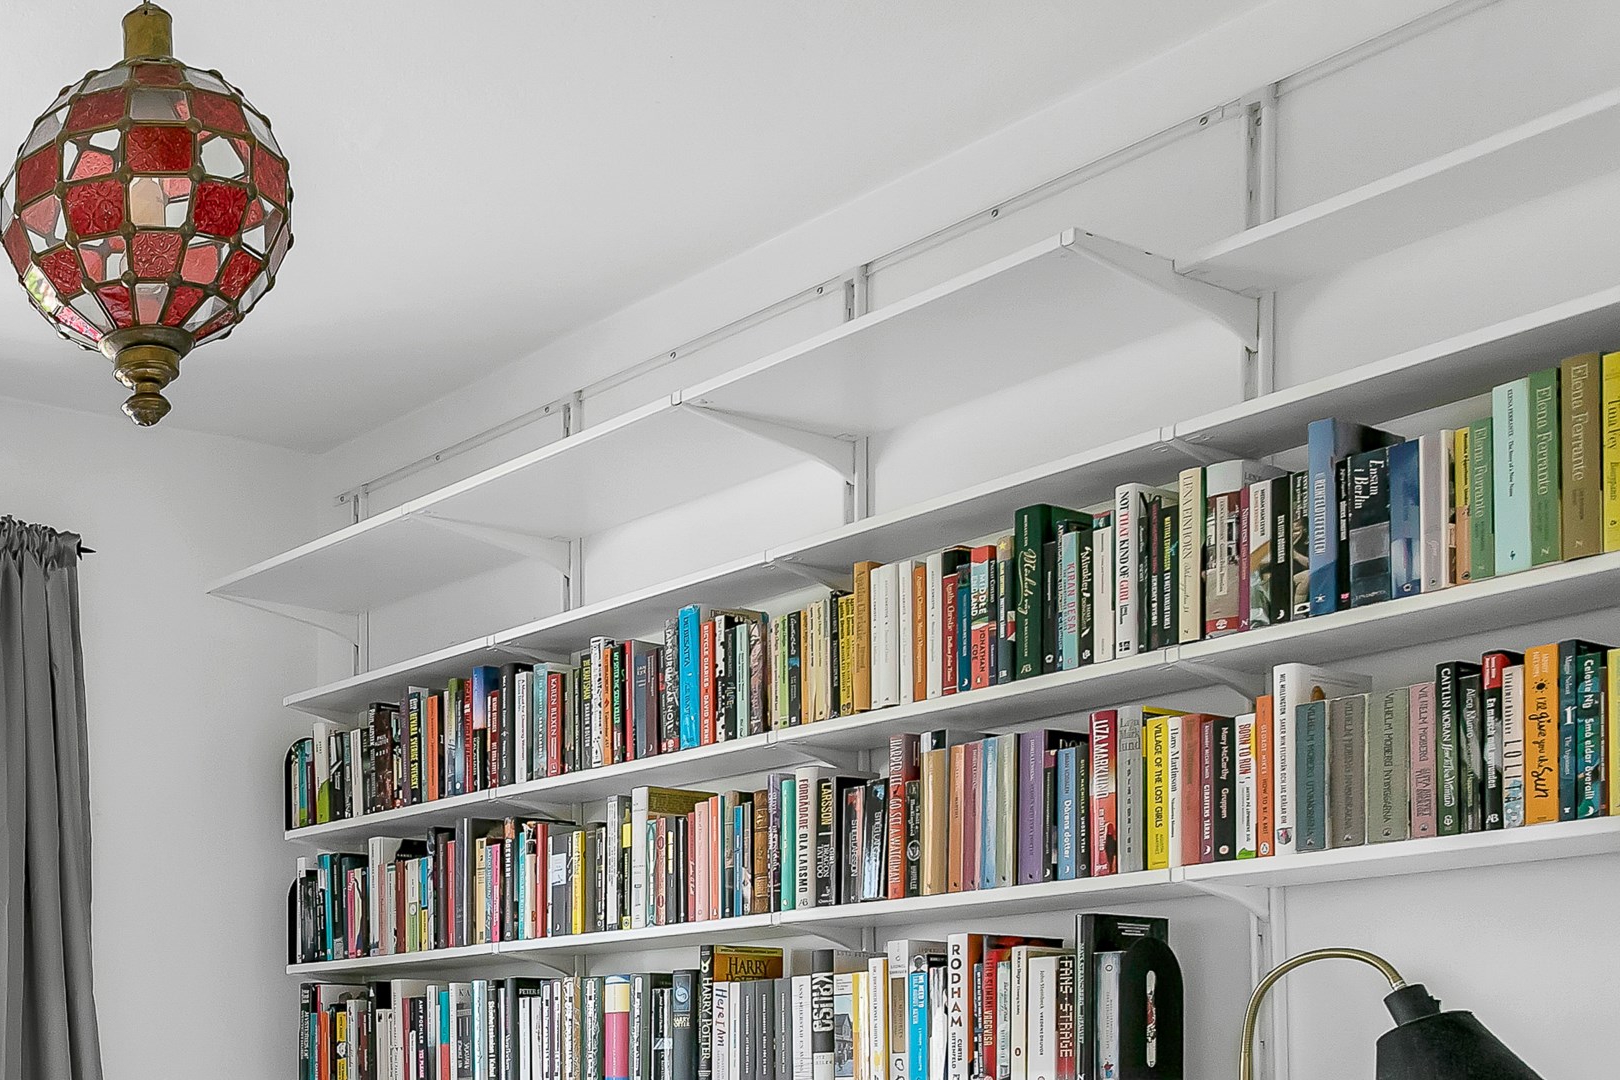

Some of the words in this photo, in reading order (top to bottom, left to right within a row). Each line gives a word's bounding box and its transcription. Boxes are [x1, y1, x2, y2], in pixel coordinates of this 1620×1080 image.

[1570, 363, 1588, 408] Elena
[1536, 386, 1552, 428] Elena
[1473, 427, 1488, 461] Elena
[1570, 412, 1588, 481] Ferrante
[1368, 460, 1385, 496] Ensam
[1536, 432, 1552, 496] Ferrante
[1119, 491, 1130, 511] NOT
[1183, 475, 1194, 506] LENA
[1353, 477, 1370, 510] Berlin
[1473, 464, 1488, 518] Ferrante
[1119, 512, 1130, 537] THAT
[1313, 479, 1326, 555] REINFELDTEFFEKTEN
[1183, 507, 1194, 560] EINHORN
[1119, 540, 1130, 564] KIND
[1067, 563, 1077, 597] KIRAN
[1081, 553, 1092, 593] Miraklet
[1119, 566, 1130, 578] OF
[971, 574, 979, 618] ENGLAND
[979, 573, 988, 615] MIDDLE
[1119, 580, 1130, 603] GIRL
[683, 616, 691, 629] DE
[1067, 602, 1077, 635] DESAI
[683, 630, 691, 667] BESATTA
[979, 630, 987, 674] JONATHAN
[550, 678, 558, 705] KAREN
[1442, 668, 1453, 708] CAITLIN
[1582, 659, 1595, 693] Celeste
[1383, 693, 1394, 731] VILHELM
[1417, 686, 1429, 724] VILHELM
[1466, 688, 1477, 709] Alice
[1537, 697, 1548, 711] I'll
[1582, 694, 1595, 709] Ng
[411, 713, 419, 736] BEVARA
[550, 708, 558, 736] BLIXEN
[1093, 719, 1109, 741] LIZA
[1220, 727, 1229, 745] Mary
[1239, 723, 1251, 745] BORN
[1442, 709, 1453, 741] MORAN
[1466, 710, 1477, 739] Munro
[1529, 713, 1552, 737] give
[1582, 718, 1595, 738] Små
[411, 738, 419, 762] SVERIGE
[889, 738, 902, 771] HARPER
[1154, 723, 1163, 756] VILLAGE
[1170, 728, 1179, 750] Harry
[1239, 747, 1251, 757] TO
[1383, 733, 1394, 767] MOBERG
[1417, 727, 1429, 762] MOBERG
[1532, 739, 1546, 753] you
[1582, 740, 1595, 764] eldar
[411, 763, 419, 790] SVENSKT
[1094, 742, 1109, 799] MARKLUND
[1154, 757, 1163, 768] OF
[1154, 770, 1163, 784] THE
[1170, 751, 1179, 792] Martinson
[1220, 746, 1229, 780] McCarthy
[1239, 758, 1251, 775] RUN
[1504, 739, 1523, 804] LOLITA
[1537, 756, 1548, 768] the
[889, 773, 902, 788] LEE
[1154, 786, 1163, 804] LOST
[1383, 769, 1394, 823] NYBYGGARNA
[1534, 767, 1554, 799] Sun
[1582, 766, 1595, 800] överallt
[798, 779, 810, 830] FÖRRÄDARE
[821, 782, 833, 826] LARSSON
[889, 798, 902, 809] GO
[1063, 799, 1072, 830] Dårens
[1154, 806, 1163, 828] GIRLS
[1220, 788, 1229, 819] Gruppen
[889, 813, 902, 827] SET
[798, 833, 808, 853] OLA
[1063, 832, 1072, 859] dotter
[798, 854, 808, 893] LARSMO
[889, 837, 902, 884] WATCHMAN
[728, 957, 771, 975] HARRY
[1060, 960, 1073, 994] FANS
[702, 977, 713, 1015] HARRY
[950, 944, 963, 1028] RODHAM
[716, 988, 728, 1019] Here
[812, 973, 834, 1032] KRUSO
[702, 1018, 713, 1061] POTTER
[717, 1028, 727, 1047] Am
[1060, 1003, 1073, 1058] STRAGE
